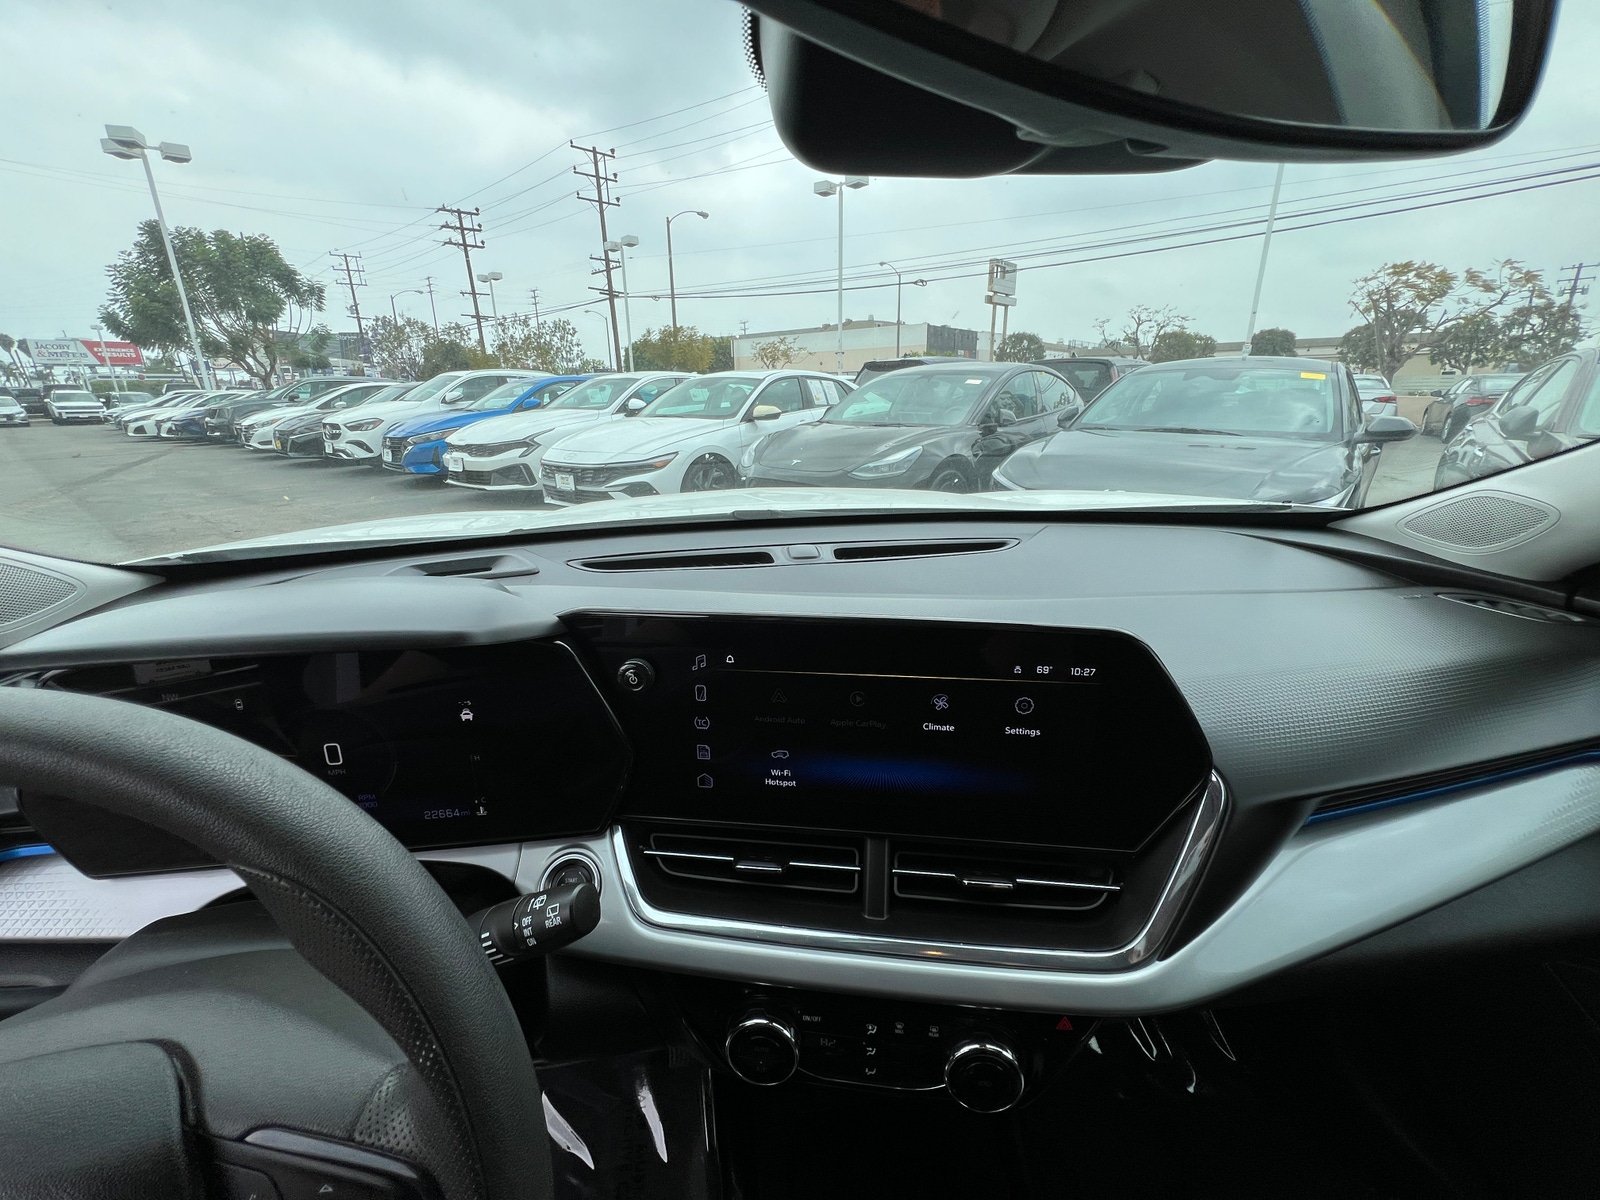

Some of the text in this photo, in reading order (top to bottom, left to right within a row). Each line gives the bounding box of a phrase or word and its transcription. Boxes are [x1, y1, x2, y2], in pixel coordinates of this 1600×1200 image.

[34, 341, 71, 350] JACOBY
[37, 349, 47, 358] &
[1070, 667, 1097, 677] 10:27
[161, 693, 180, 701] NW
[754, 714, 806, 725] Android Auto
[830, 719, 887, 731] Apple CarPlay
[923, 723, 955, 732] Climate
[1005, 727, 1041, 737] Settings
[323, 743, 344, 766] 0
[770, 768, 792, 778] Wi-Fi
[764, 778, 797, 788] Hotspot
[357, 793, 377, 801] RPM
[423, 808, 460, 820] 22664
[522, 916, 532, 926] OFF
[545, 917, 562, 928] REAR
[523, 927, 533, 937] INT
[527, 938, 537, 946] ON
